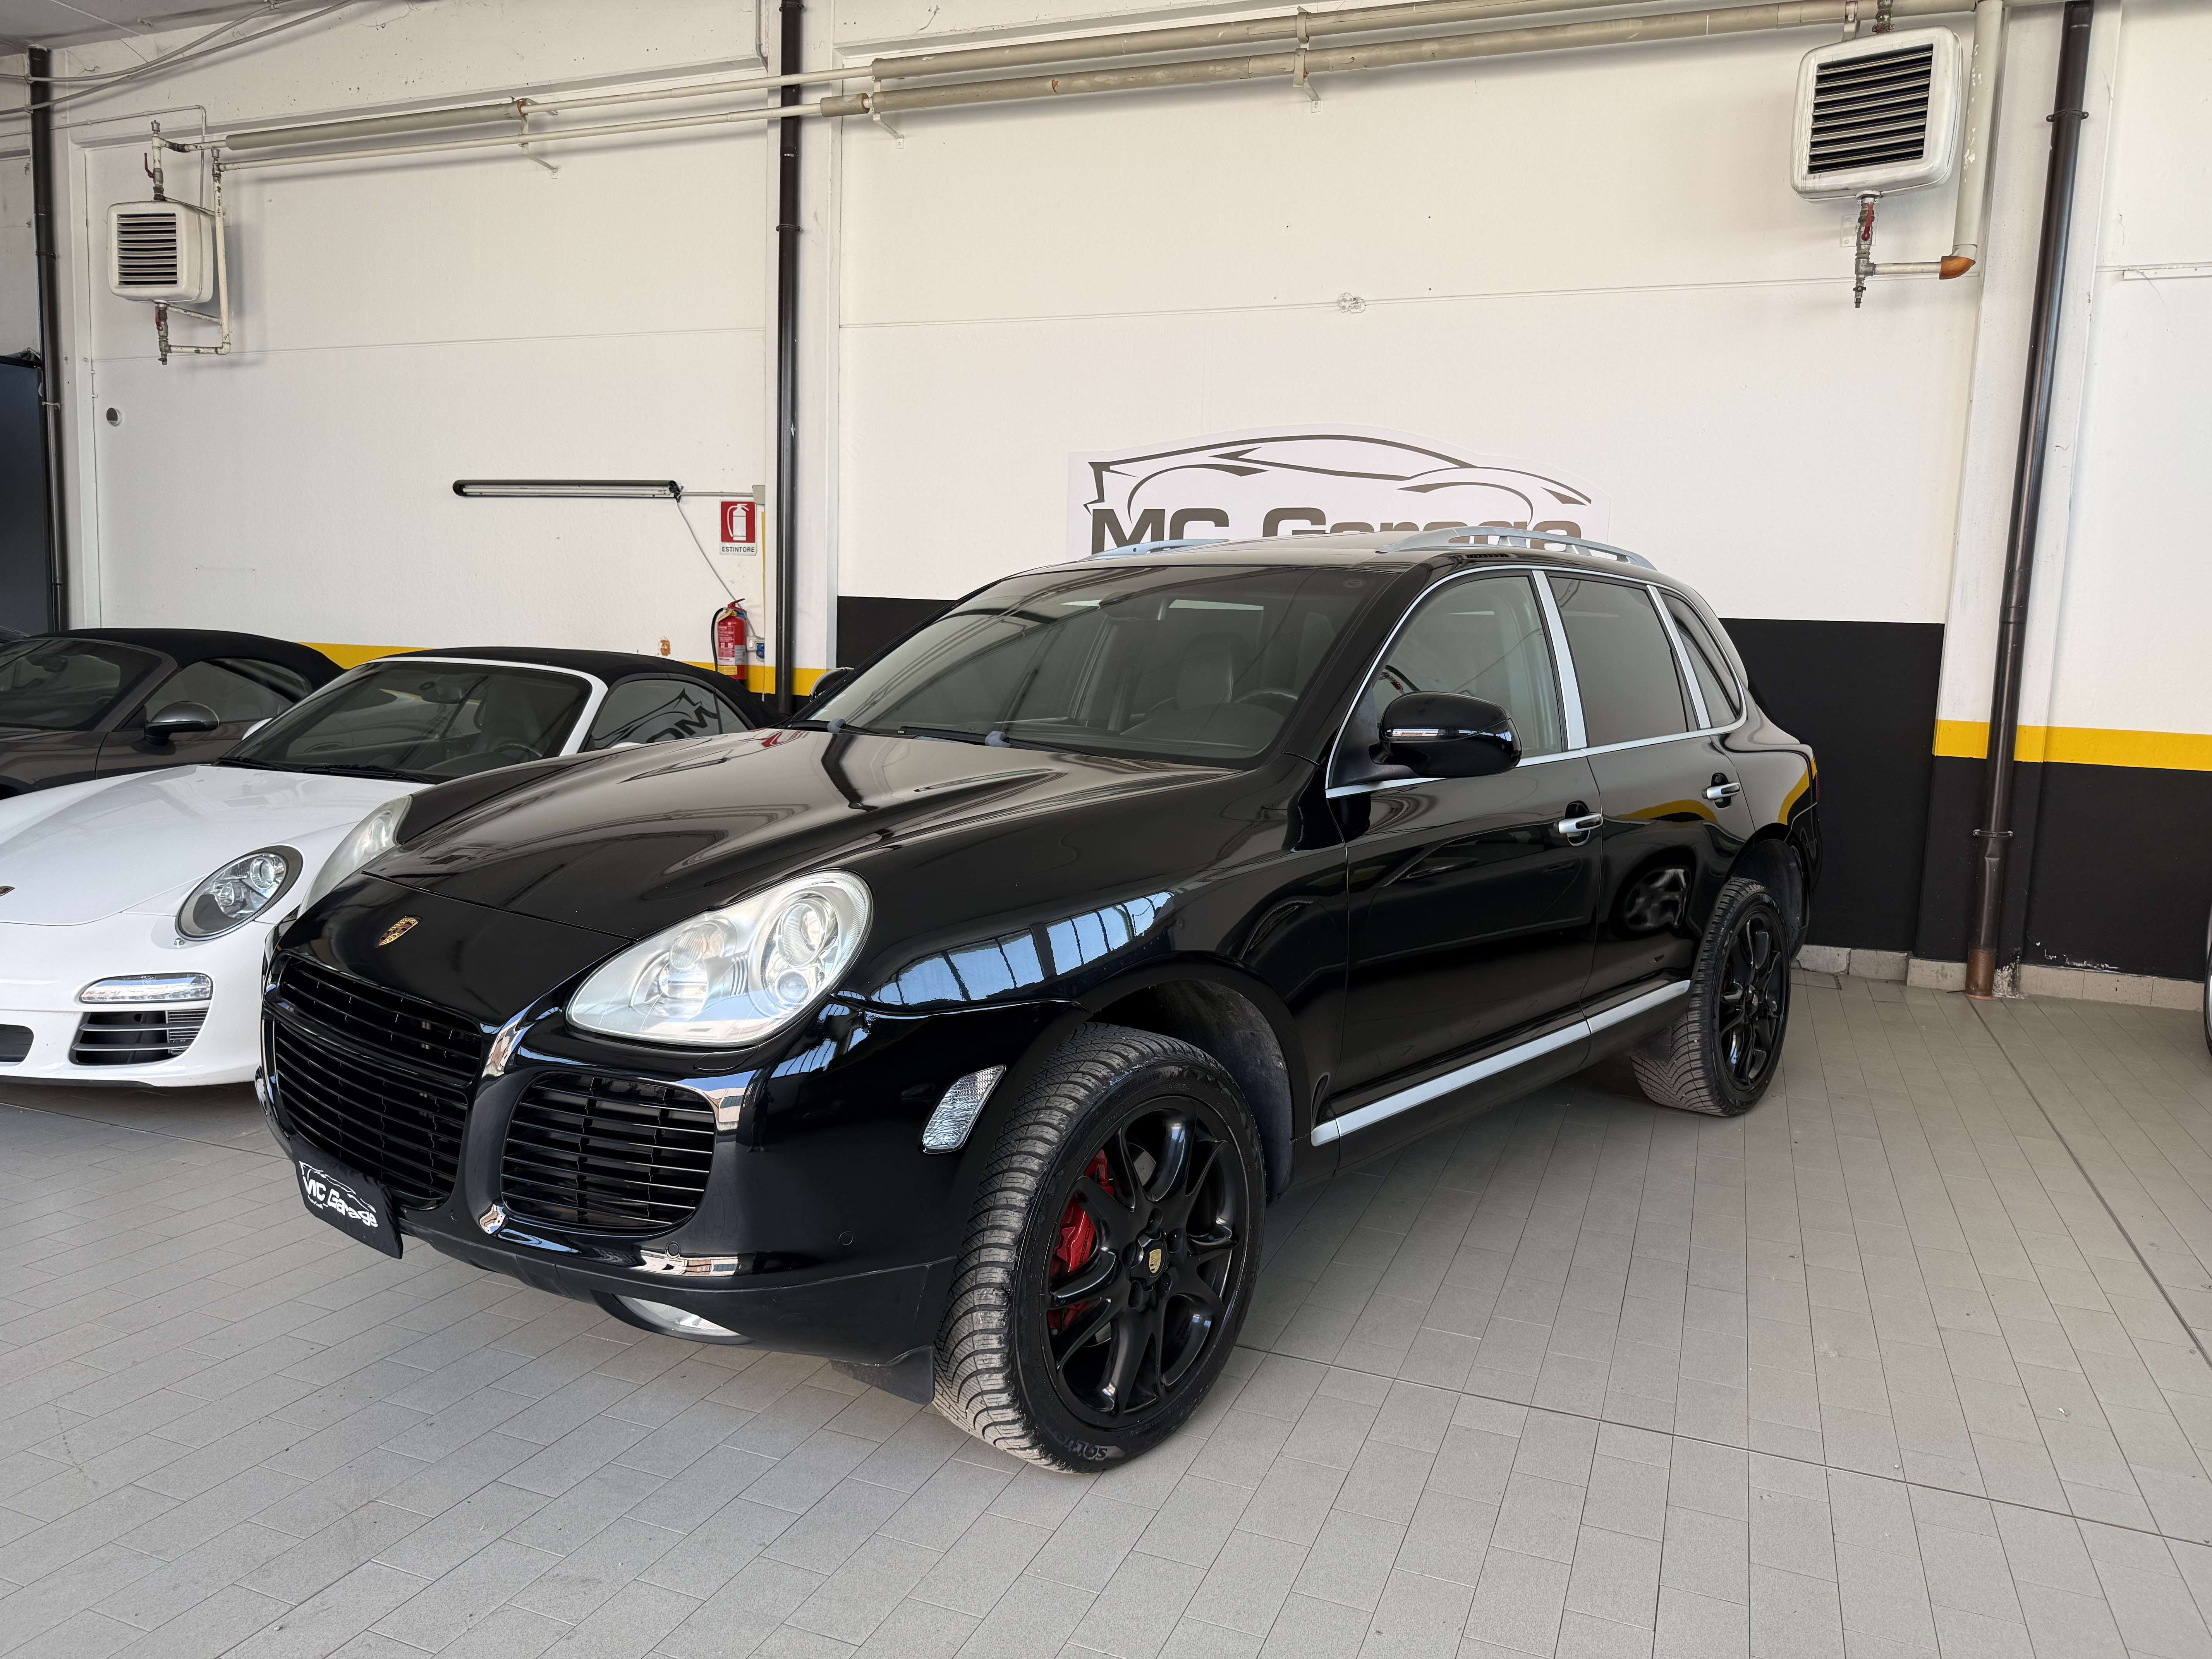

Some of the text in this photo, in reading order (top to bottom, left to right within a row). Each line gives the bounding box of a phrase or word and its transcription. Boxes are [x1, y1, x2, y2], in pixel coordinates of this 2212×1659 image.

[1092, 508, 1229, 555] MC
[327, 1188, 378, 1227] Garage
[1079, 1218, 1091, 1264] RSCH
